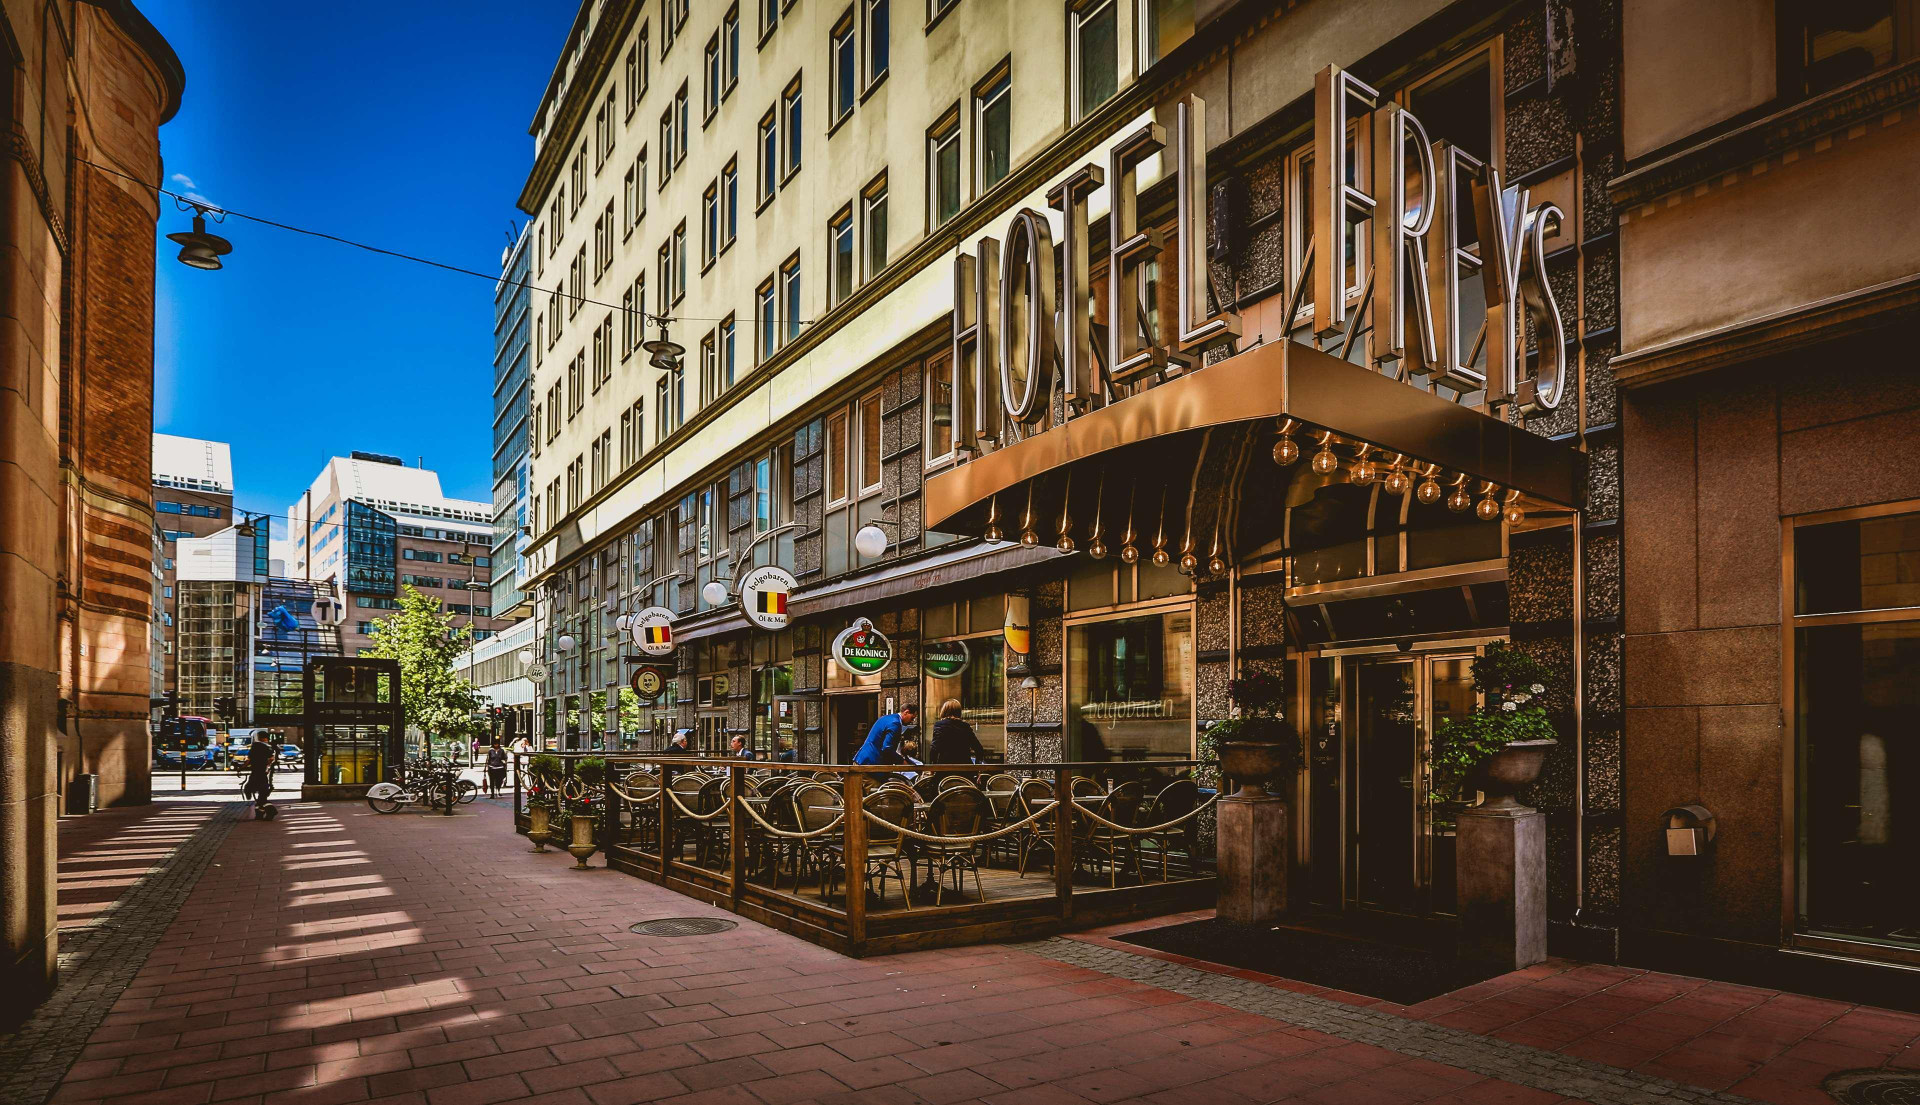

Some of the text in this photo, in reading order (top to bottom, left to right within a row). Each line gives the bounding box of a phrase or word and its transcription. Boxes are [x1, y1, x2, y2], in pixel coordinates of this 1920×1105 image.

[952, 63, 1565, 449] HOTEL FREYS
[316, 601, 331, 621] T
[333, 602, 342, 622] T
[844, 647, 888, 658] DE KONINCK
[1089, 687, 1173, 730] belgobaren
